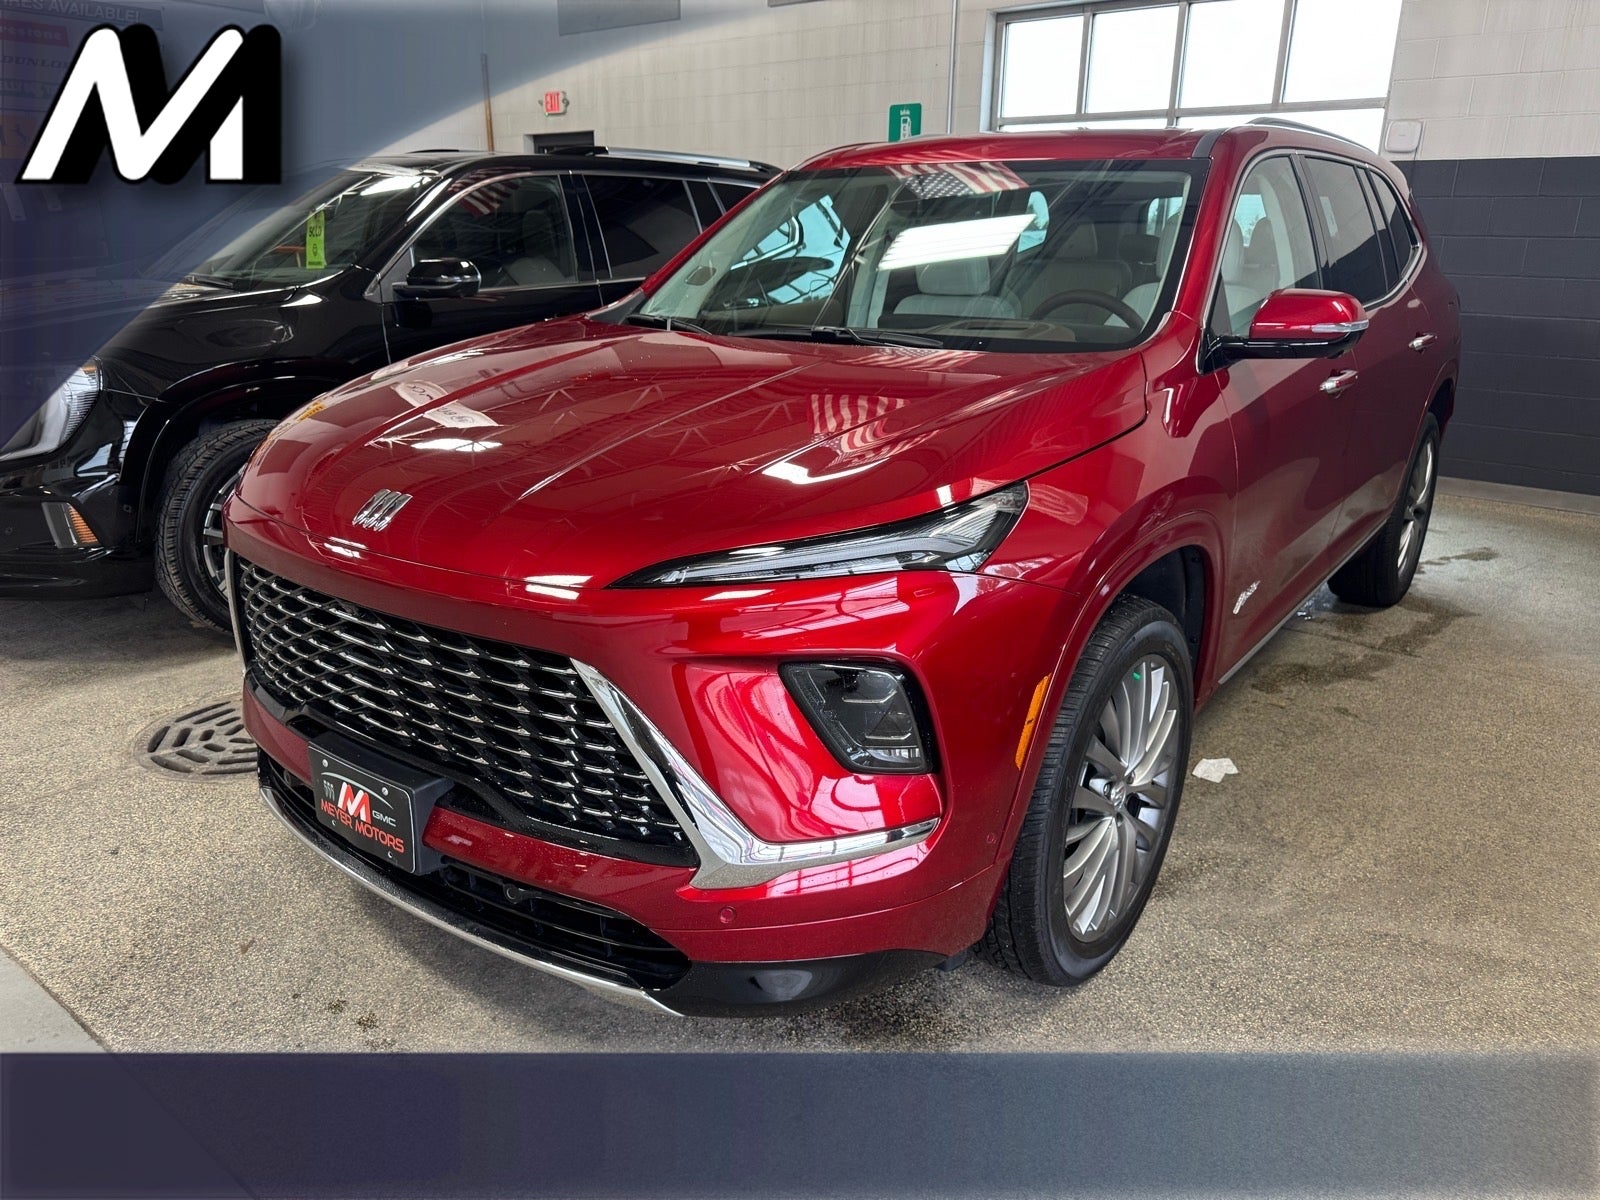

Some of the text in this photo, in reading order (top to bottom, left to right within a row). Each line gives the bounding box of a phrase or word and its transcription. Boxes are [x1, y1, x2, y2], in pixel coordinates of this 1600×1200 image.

[47, 0, 140, 23] AVAILABLE!
[545, 91, 560, 112] EXIT
[320, 798, 405, 853] MEYER MOTORS
[372, 810, 397, 827] GMC
